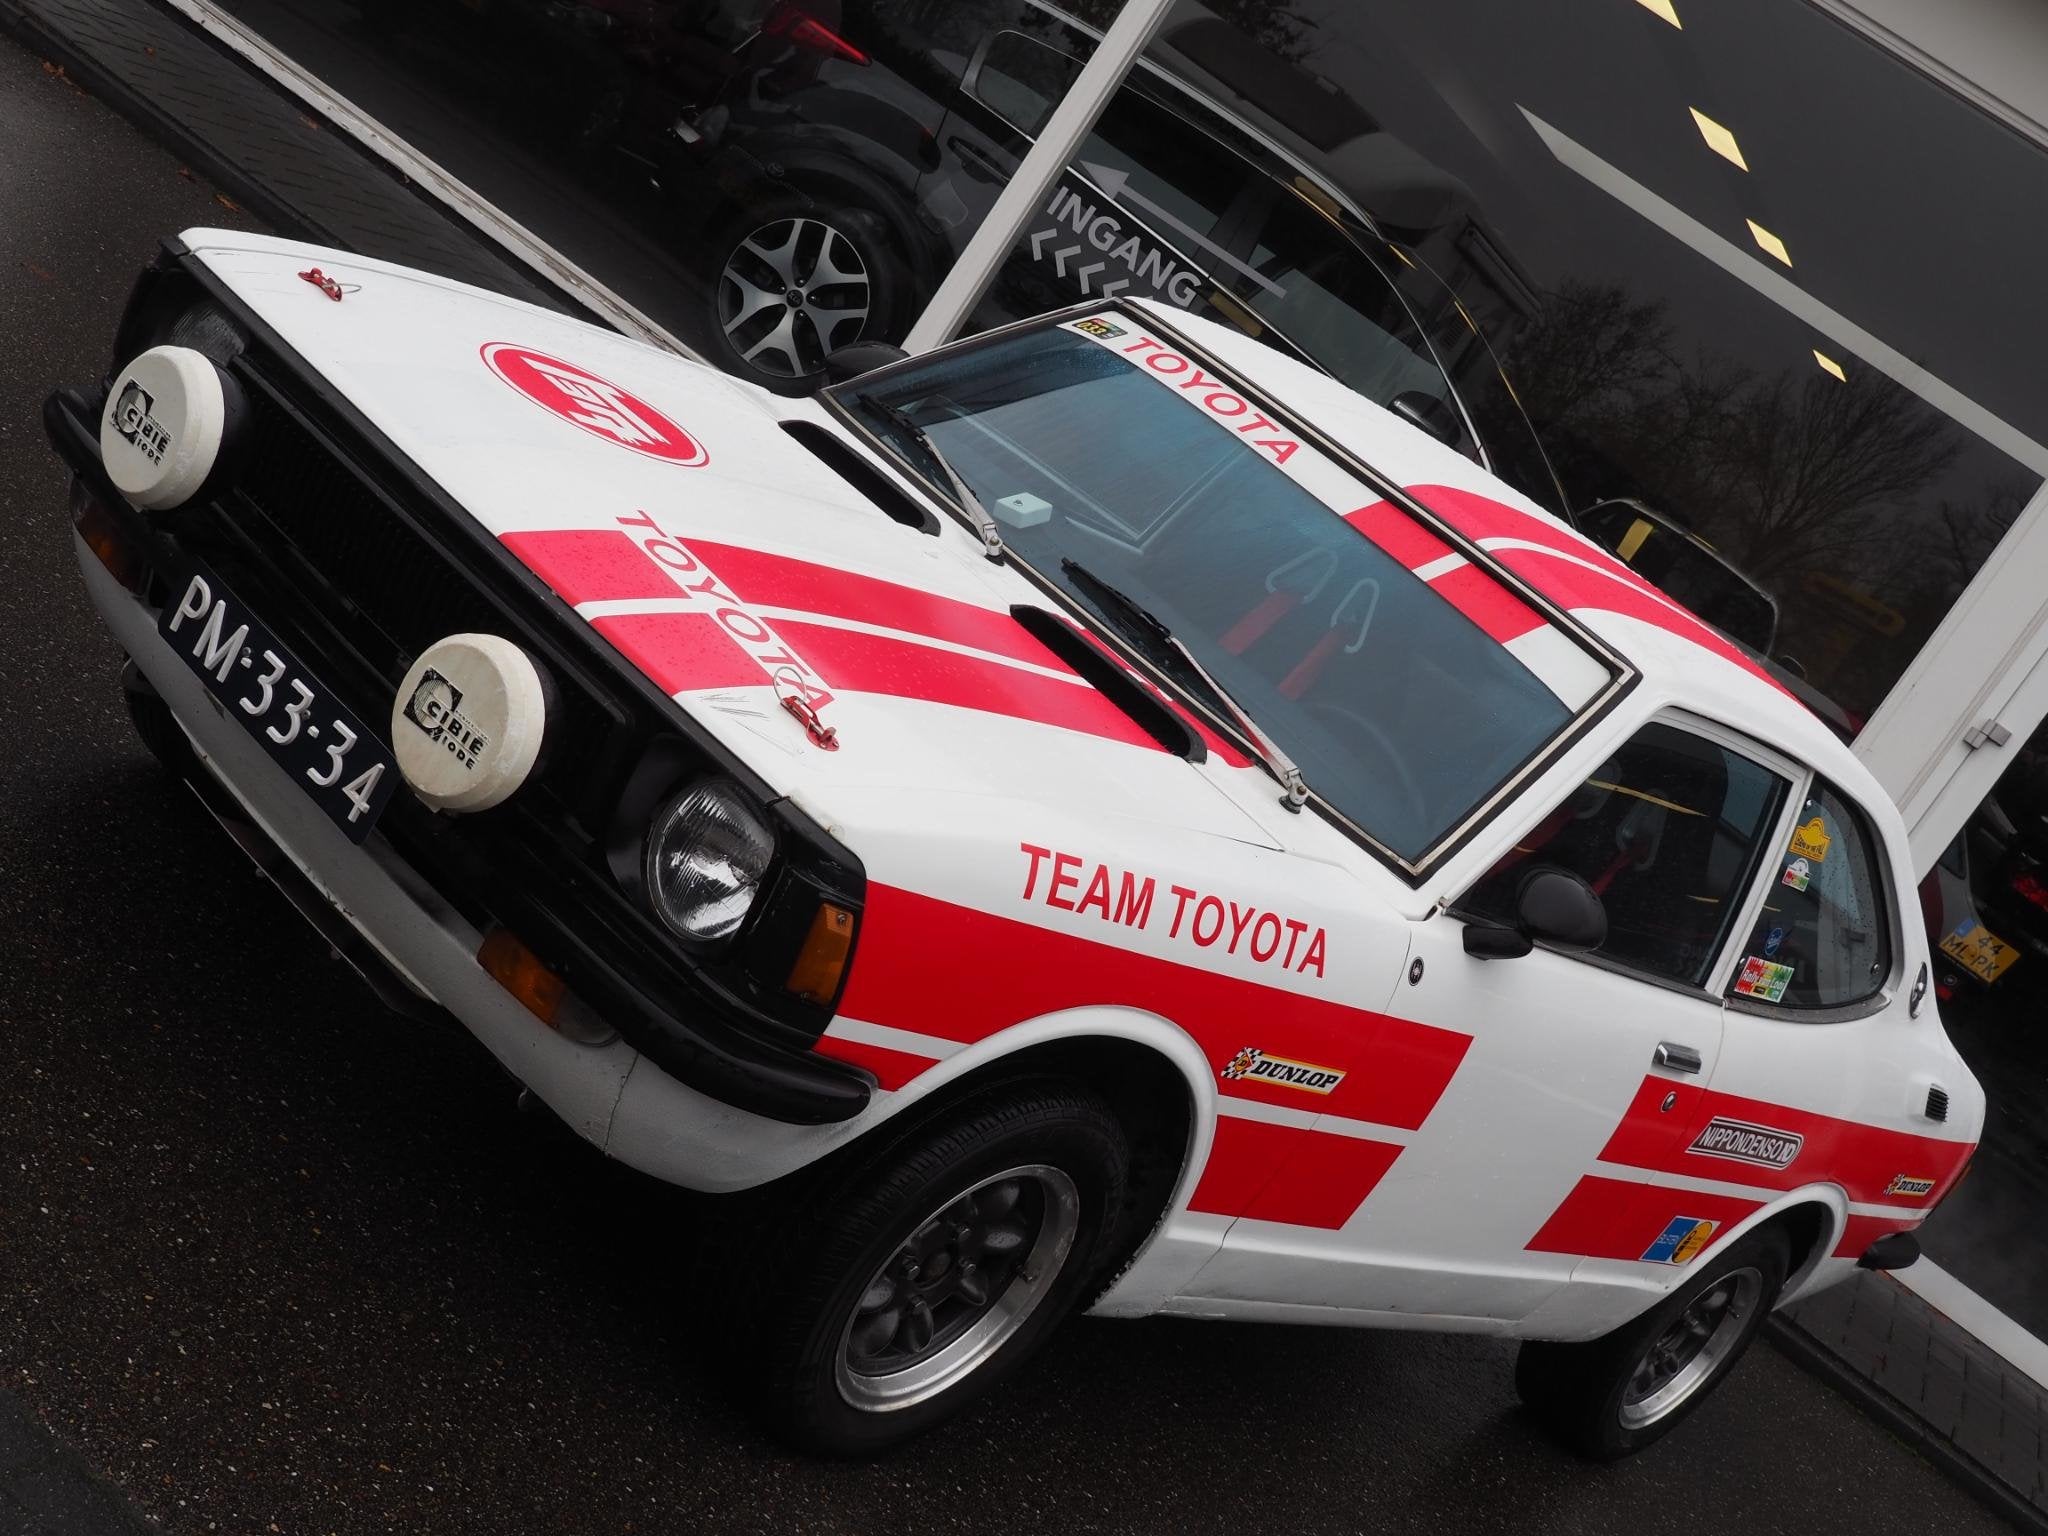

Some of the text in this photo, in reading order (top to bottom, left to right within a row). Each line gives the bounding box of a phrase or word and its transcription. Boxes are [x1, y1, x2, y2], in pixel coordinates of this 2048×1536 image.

[1046, 187, 1202, 308] INGANG
[1122, 337, 1300, 464] TOYOTA
[127, 407, 168, 454] CIBIE
[136, 438, 163, 467] IODE
[617, 509, 836, 710] TOYOTA
[427, 698, 485, 758] CIBIE
[441, 736, 475, 770] IODE
[1020, 843, 1327, 979] TEAM TOYOTA
[1943, 936, 1999, 977] ML-PK
[1978, 937, 2005, 955] 44
[1250, 1060, 1340, 1088] DUNLOP
[1699, 1126, 1783, 1159] NIPPONDENSO
[1897, 1180, 1932, 1193] DUNLOP
